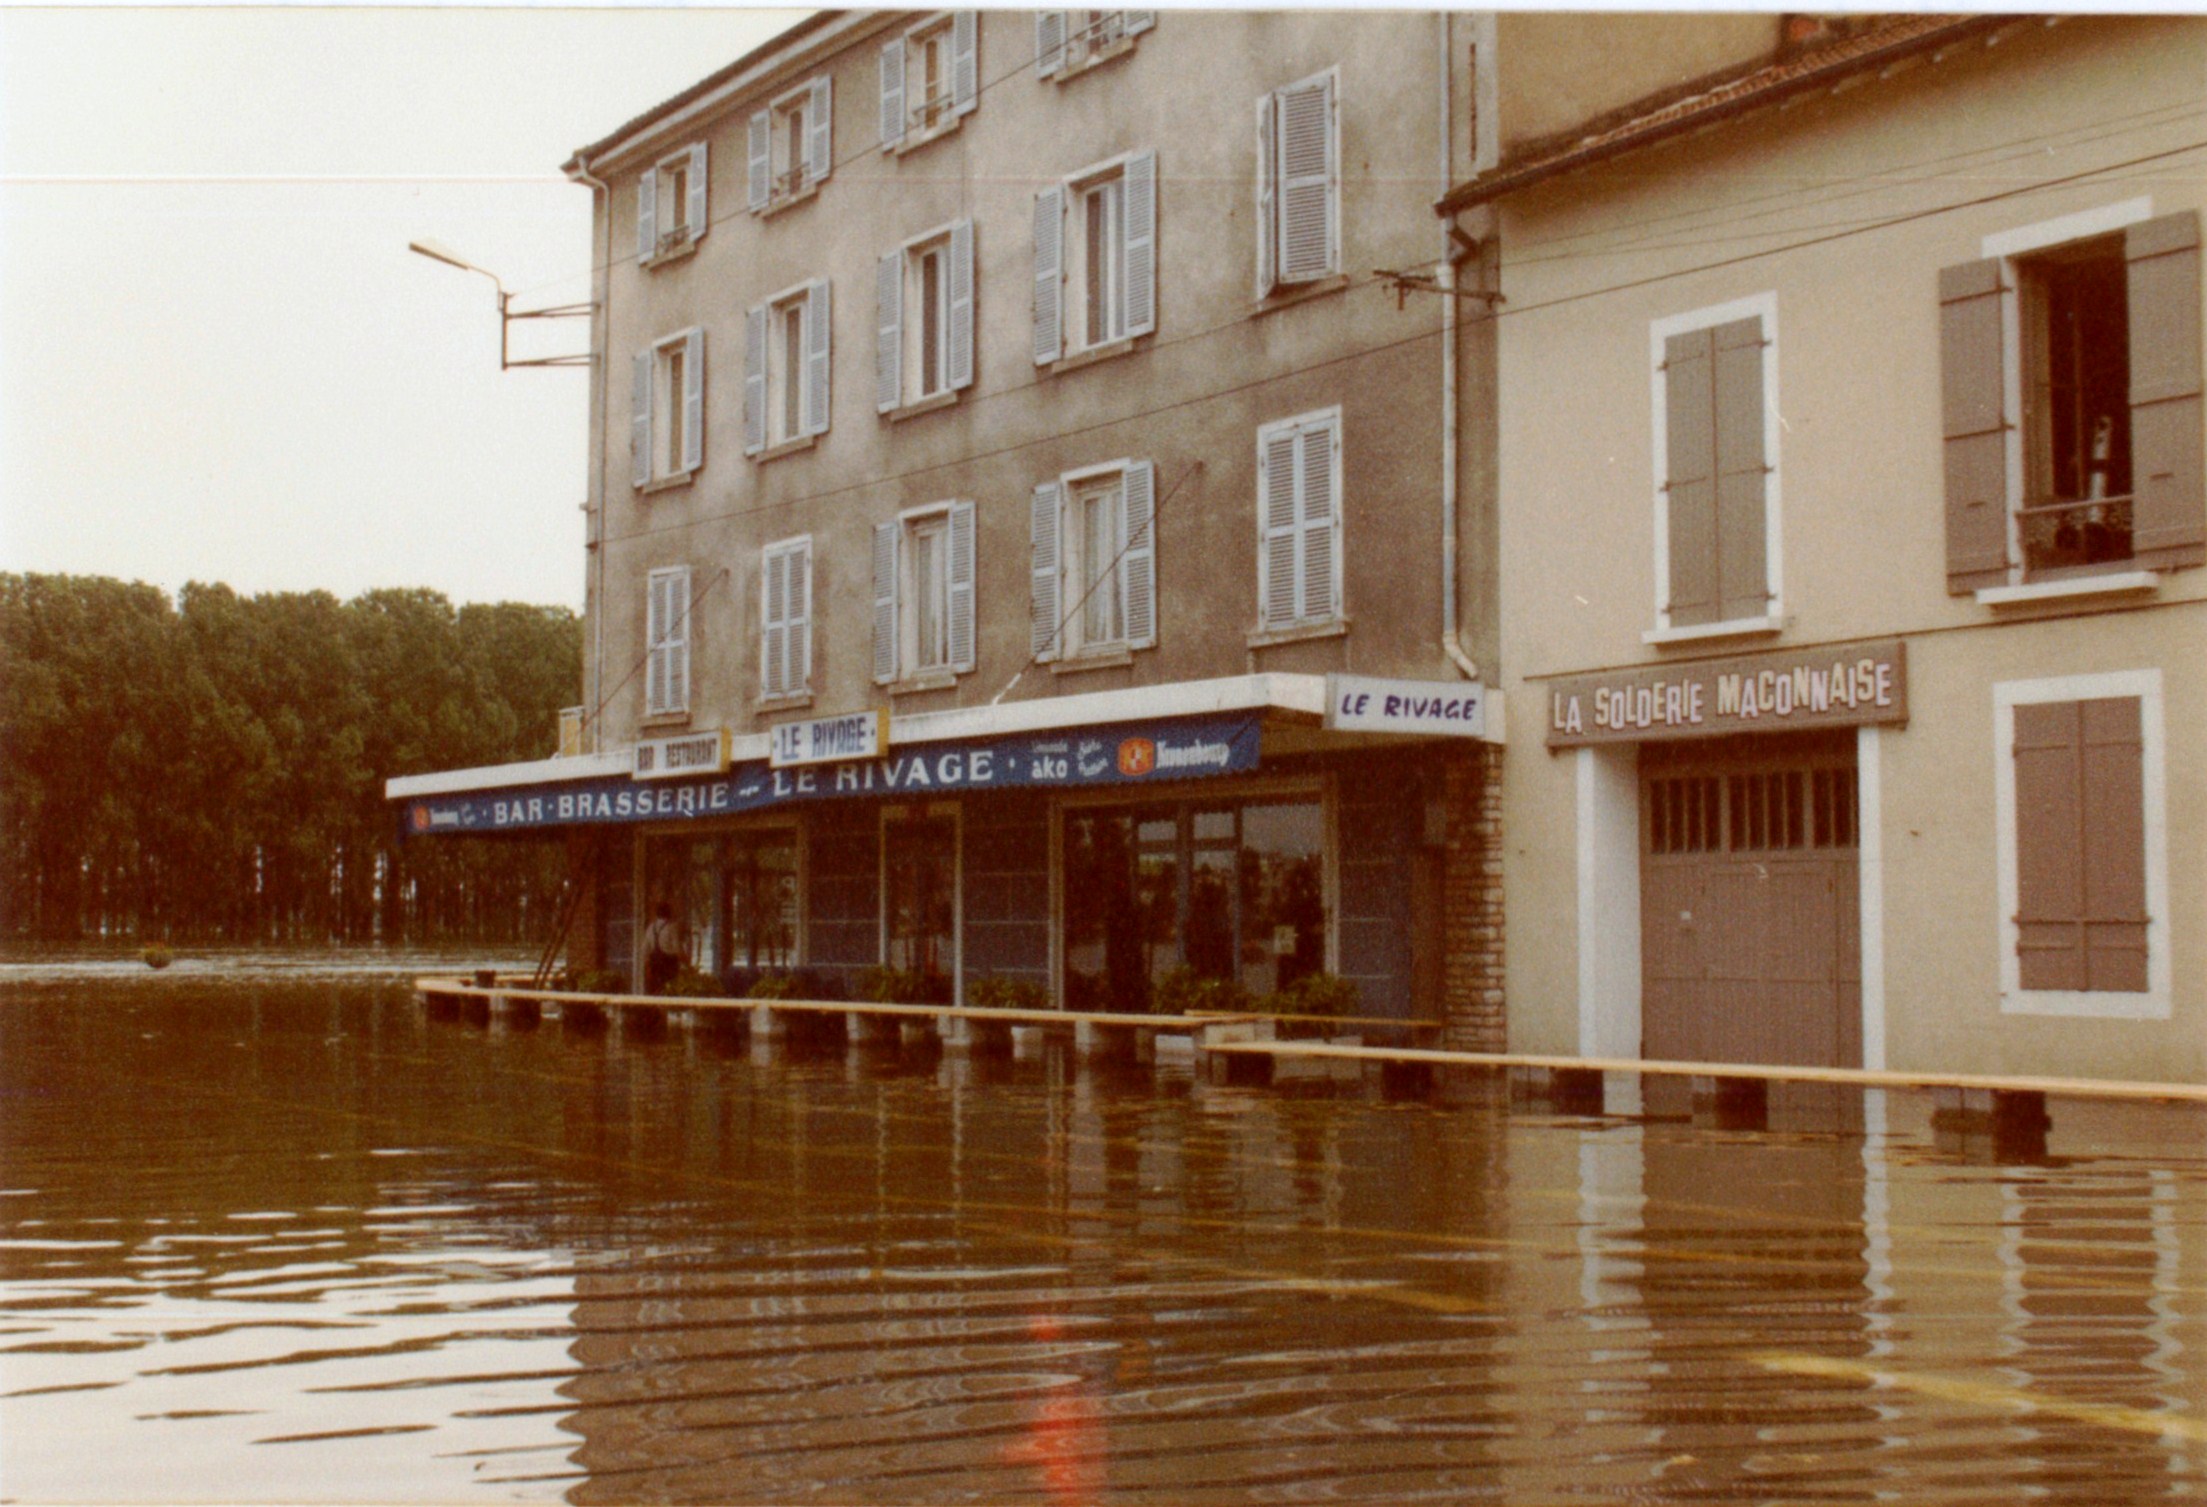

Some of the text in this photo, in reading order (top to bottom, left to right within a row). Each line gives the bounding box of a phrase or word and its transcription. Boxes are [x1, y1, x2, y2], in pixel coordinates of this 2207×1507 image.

[1340, 693, 1477, 721] LE RIVAGE
[1553, 658, 1892, 733] LA SOLDERIE MACONNAISE
[665, 737, 718, 769] RESTAURANT
[781, 716, 867, 761] LE RIVAGE
[494, 798, 544, 825] BAR
[557, 782, 729, 817] BRASSERIE
[773, 769, 817, 797] LE
[836, 750, 994, 791] RIVAGE
